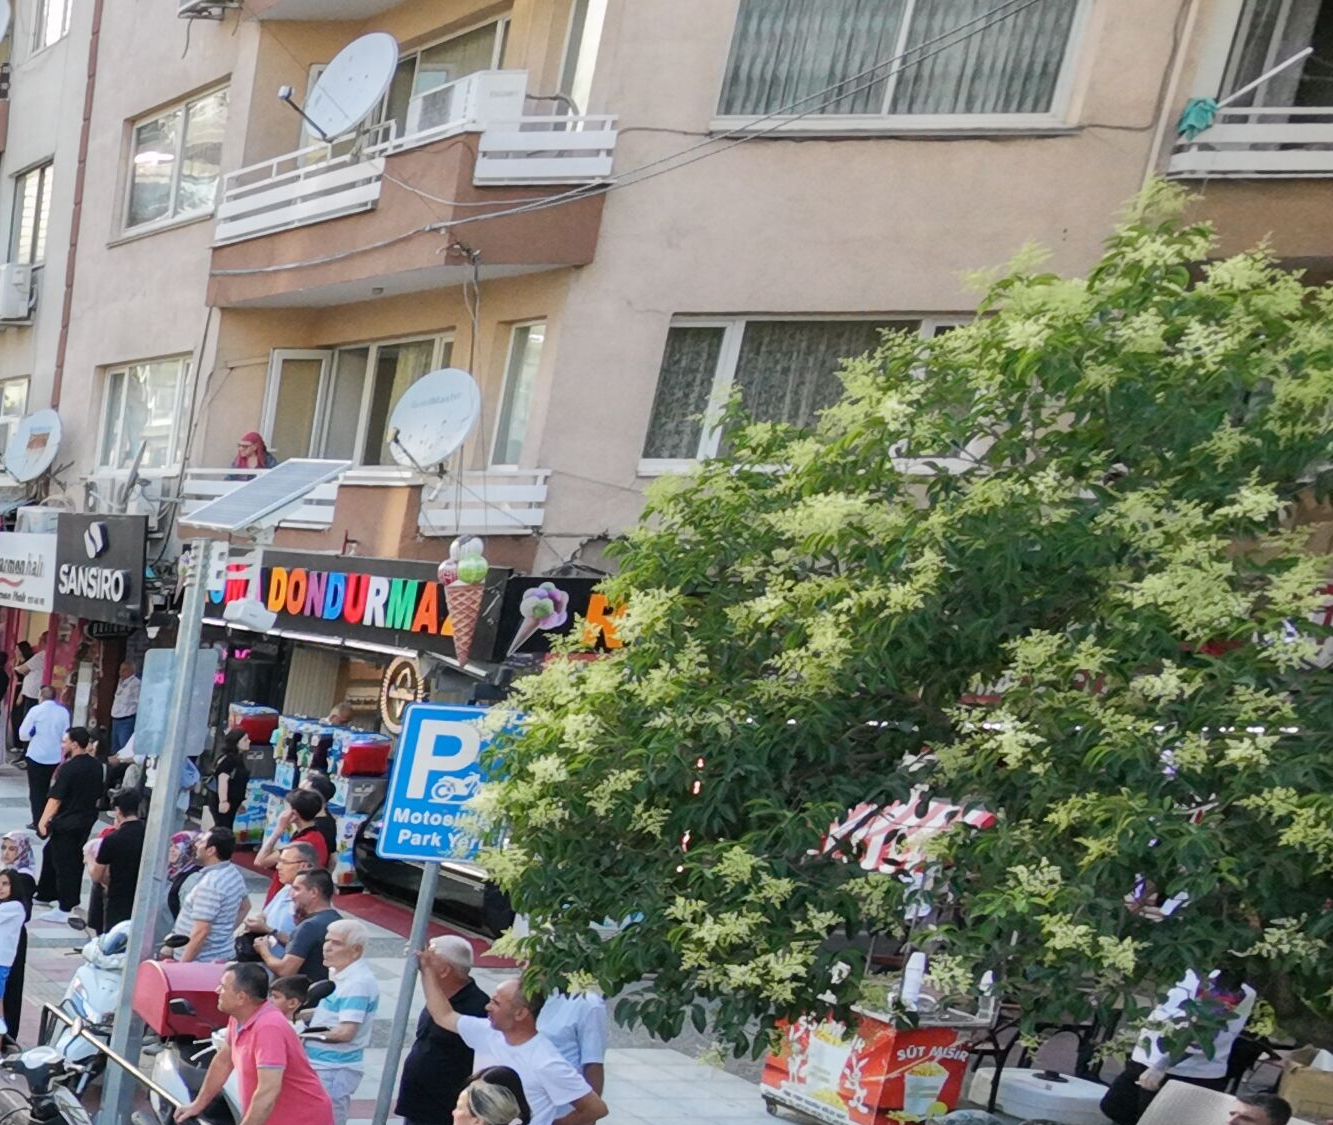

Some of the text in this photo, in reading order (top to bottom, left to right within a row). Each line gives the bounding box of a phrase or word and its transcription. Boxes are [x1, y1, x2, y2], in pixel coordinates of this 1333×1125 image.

[267, 566, 438, 635] DONDURMA
[405, 718, 481, 799] P
[397, 829, 443, 848] Park
[896, 1046, 970, 1063] SÜT MISIR
